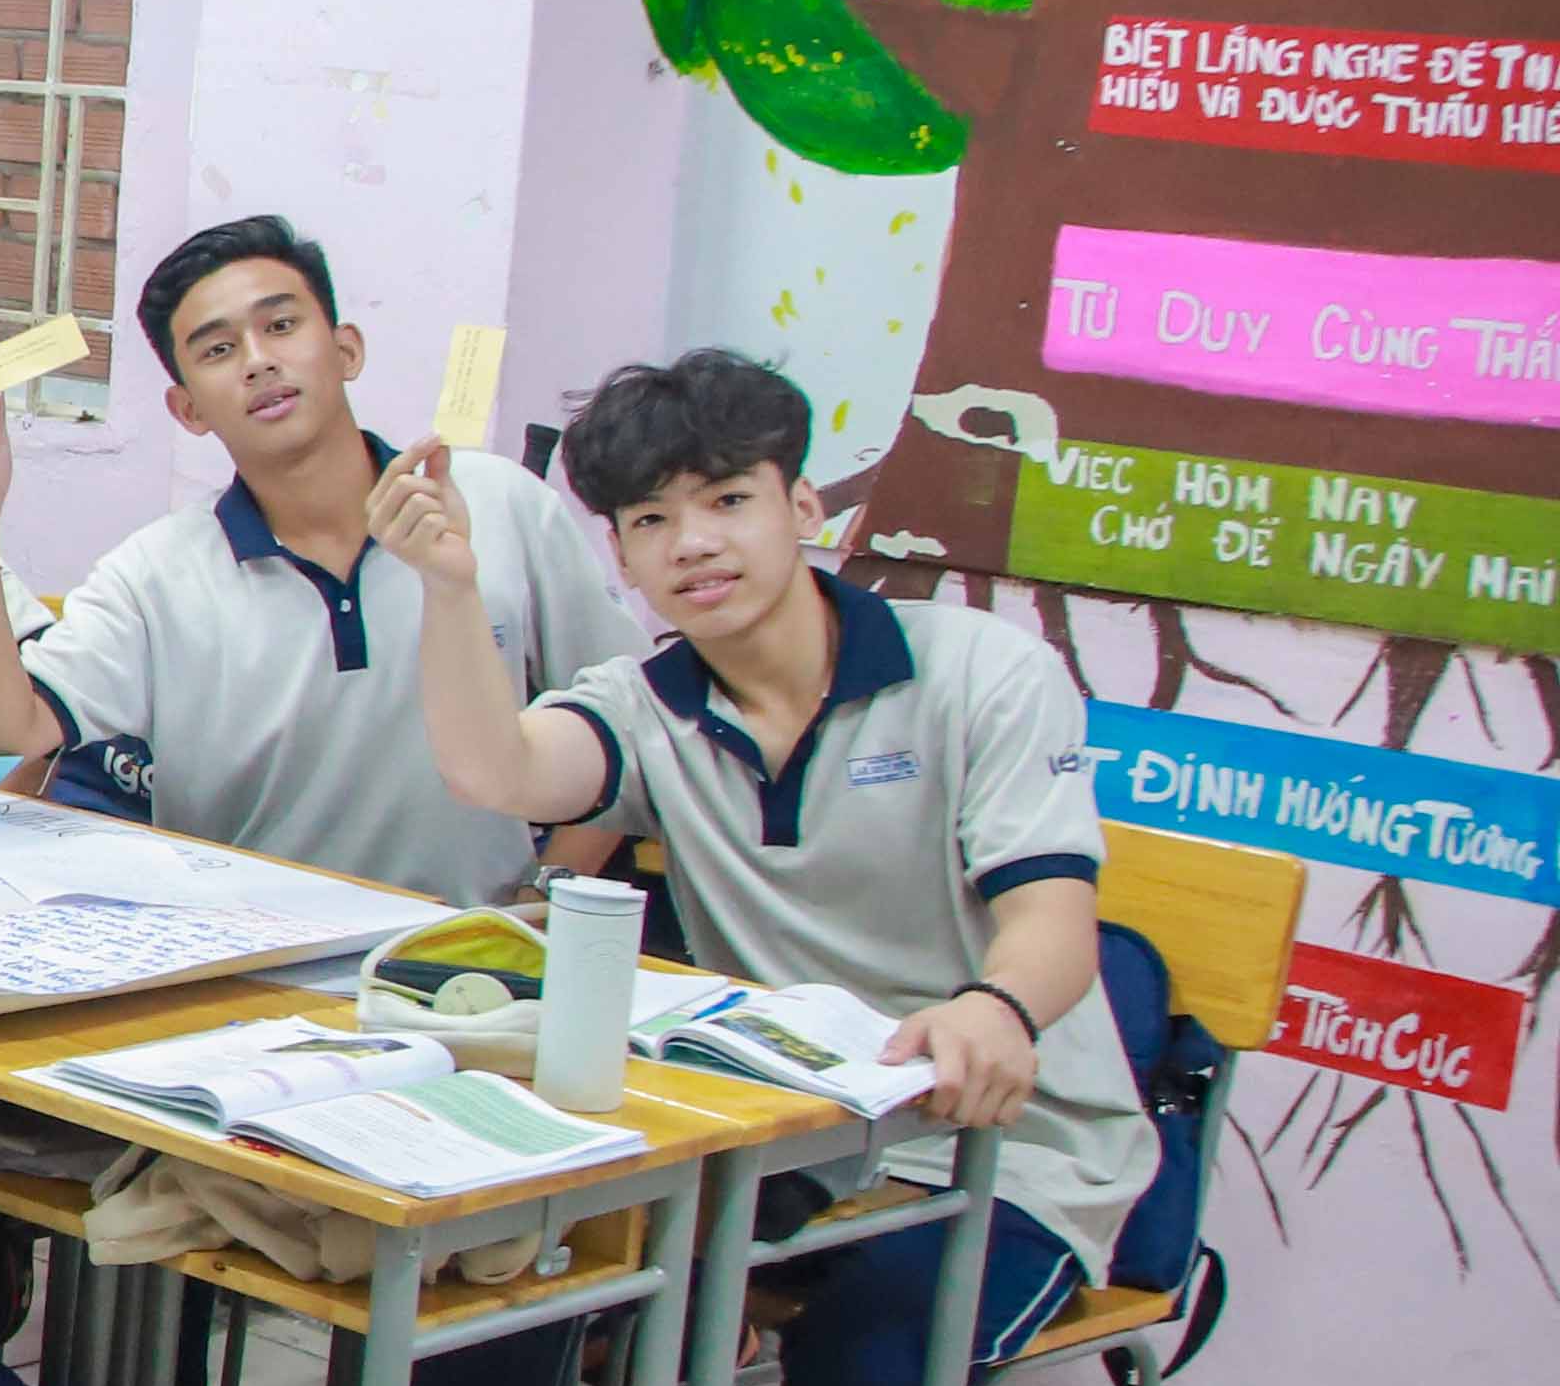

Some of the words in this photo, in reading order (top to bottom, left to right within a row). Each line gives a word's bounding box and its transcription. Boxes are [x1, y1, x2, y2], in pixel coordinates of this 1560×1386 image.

[1312, 39, 1419, 82] NGHE
[1156, 289, 1274, 356] DUY
[1309, 301, 1443, 375] CÙNG
[1173, 451, 1274, 516] HÔM
[1306, 473, 1419, 528] NAY
[1467, 553, 1557, 607] MAI
[1126, 750, 1266, 822] ĐỊNH
